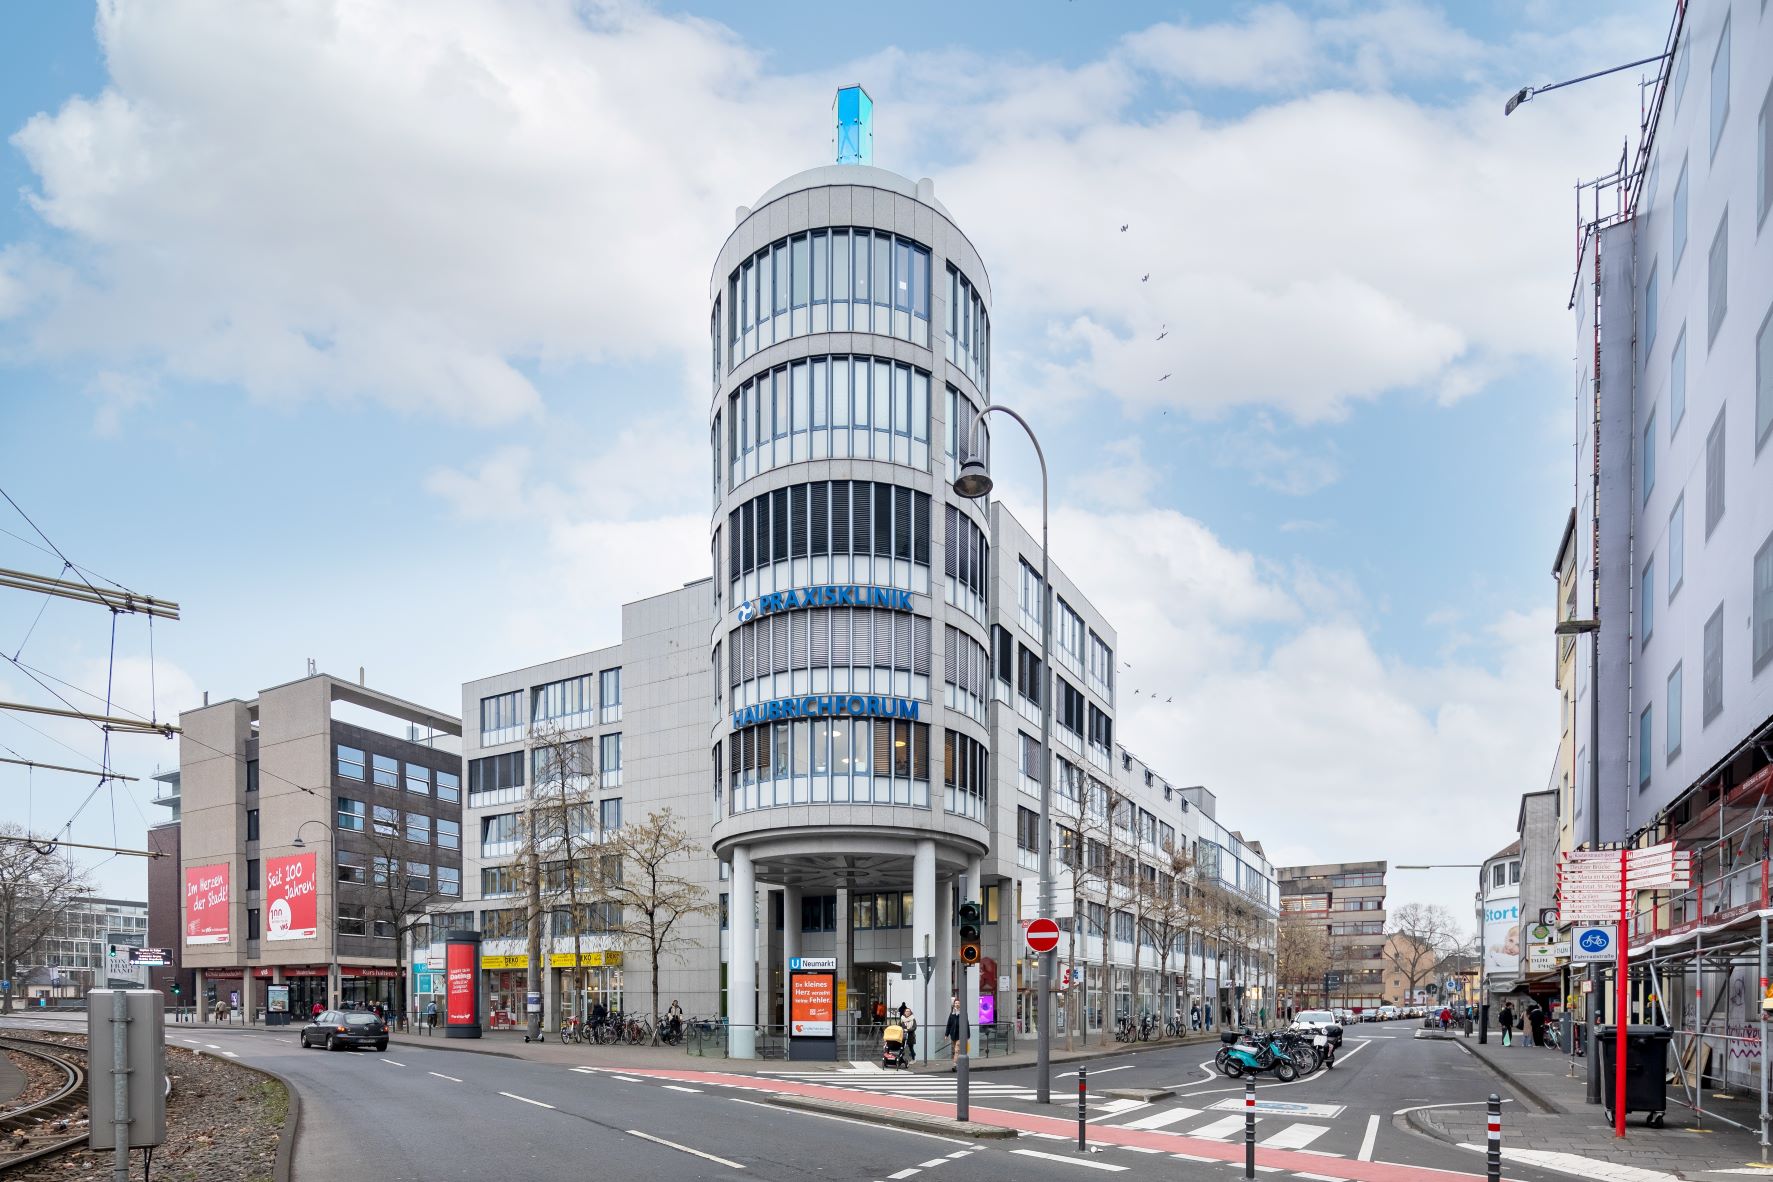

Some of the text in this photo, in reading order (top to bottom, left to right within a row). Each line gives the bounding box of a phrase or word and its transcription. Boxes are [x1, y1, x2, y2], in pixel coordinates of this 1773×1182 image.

[759, 585, 913, 615] PRAXISKLINIK
[733, 695, 919, 730] HAUBRICHFORUM
[188, 875, 224, 896] Im Herzen
[268, 862, 302, 889] Seit 100
[285, 872, 315, 899] Jahren!
[193, 885, 228, 911] der Stadt!
[791, 959, 800, 969] U
